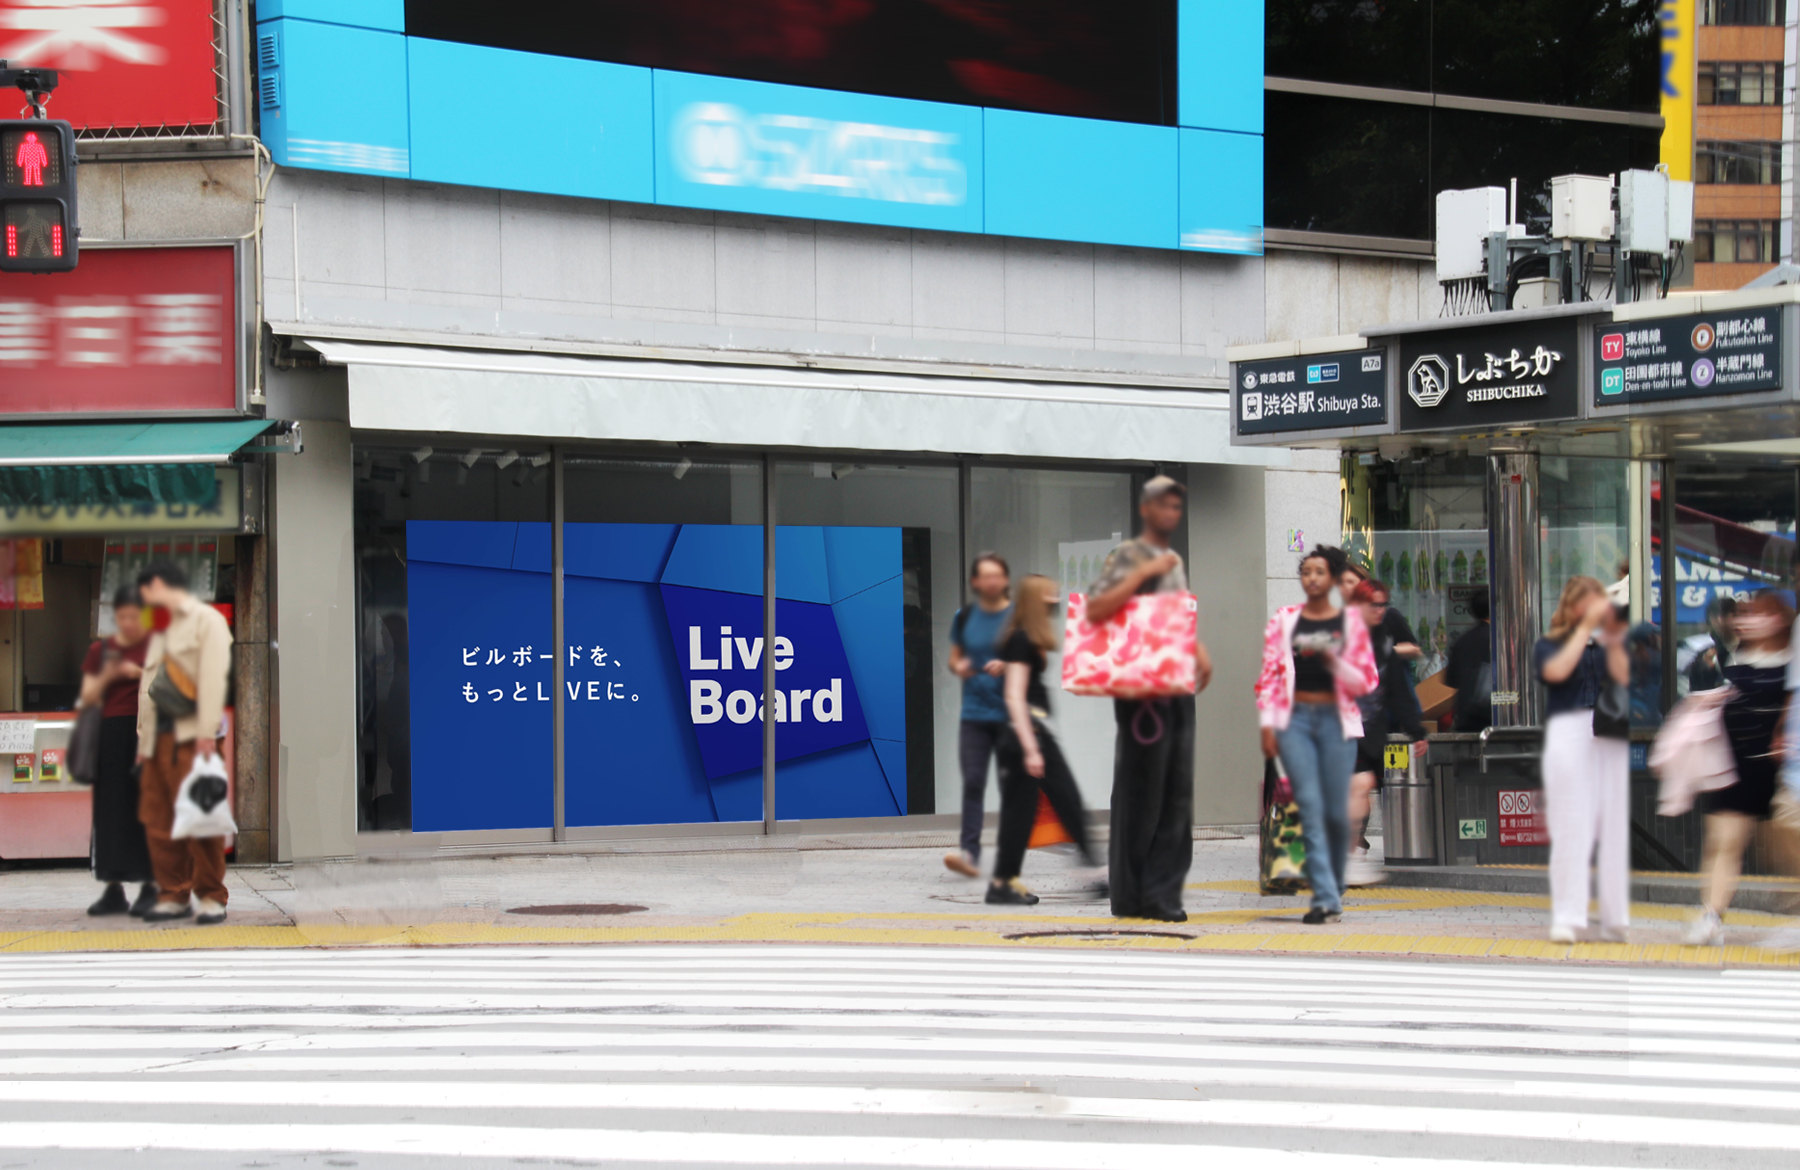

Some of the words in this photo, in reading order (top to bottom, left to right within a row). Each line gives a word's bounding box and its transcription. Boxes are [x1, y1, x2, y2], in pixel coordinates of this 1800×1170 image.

[1716, 316, 1766, 337] 副都心線
[1625, 328, 1661, 346] 東横線
[1715, 335, 1757, 349] Fukutoshin
[1758, 332, 1773, 344] Line
[1605, 341, 1620, 353] TY
[1625, 344, 1651, 360] Toyoko
[1652, 342, 1667, 354] Line
[1363, 358, 1380, 370] A7a
[1456, 345, 1562, 384] しぶちか
[1625, 361, 1683, 381] 田園都市線
[1716, 353, 1765, 372] 半蔵門線
[1259, 370, 1296, 385] 東急電鉄
[1605, 375, 1620, 387] DT
[1625, 378, 1670, 392] Den-en-toshi
[1671, 376, 1687, 388] Line
[1715, 371, 1756, 384] Hanzomon
[1757, 369, 1773, 380] Line
[1467, 384, 1545, 402] SHIBUCHIKA
[1263, 390, 1315, 417] 渋谷駅
[1317, 395, 1358, 414] Shibuya
[1361, 393, 1381, 409] Sta.
[462, 645, 621, 667] ビルボードを、
[689, 626, 794, 670] Live
[462, 681, 639, 703] もっとLVEに。
[690, 678, 843, 724] Board
